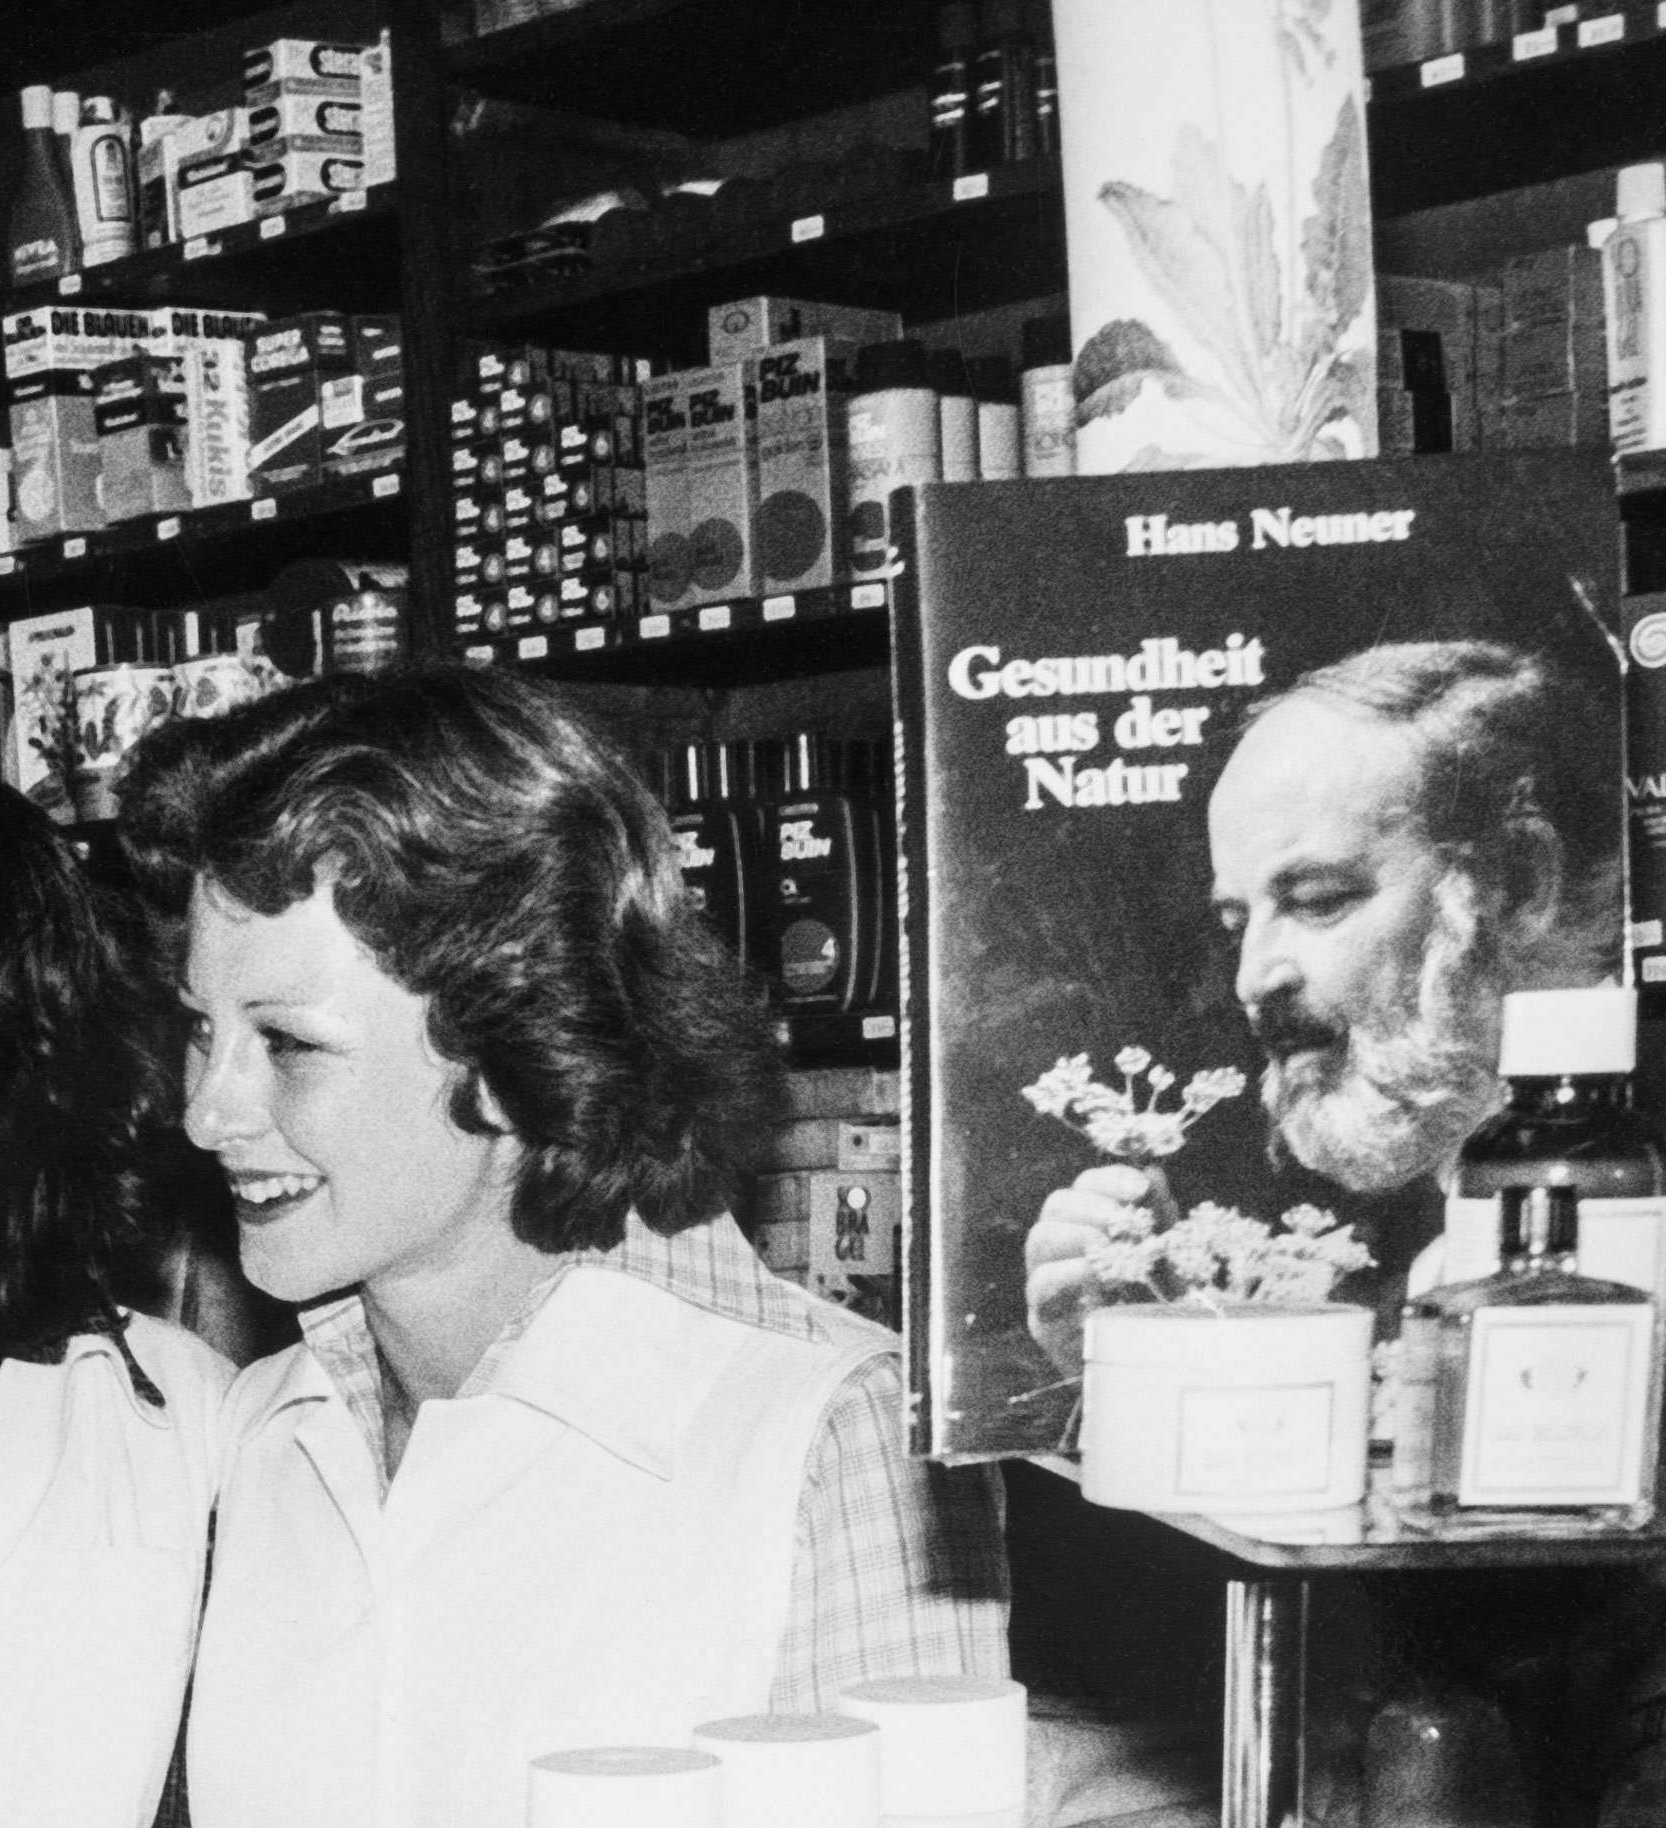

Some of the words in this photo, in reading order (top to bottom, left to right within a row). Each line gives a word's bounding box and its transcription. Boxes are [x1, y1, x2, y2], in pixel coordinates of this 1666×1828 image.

[202, 313, 250, 341] BLAU
[759, 352, 803, 382] PIZ
[688, 388, 722, 412] PIZ
[760, 371, 822, 402] BUIN
[690, 404, 736, 427] BUIN
[1124, 513, 1239, 558] Hans
[1250, 507, 1417, 552] Neuner
[947, 632, 1266, 699] Gesundheit
[1005, 705, 1099, 756] aus
[1114, 697, 1211, 748] der
[1022, 756, 1190, 811] Natur
